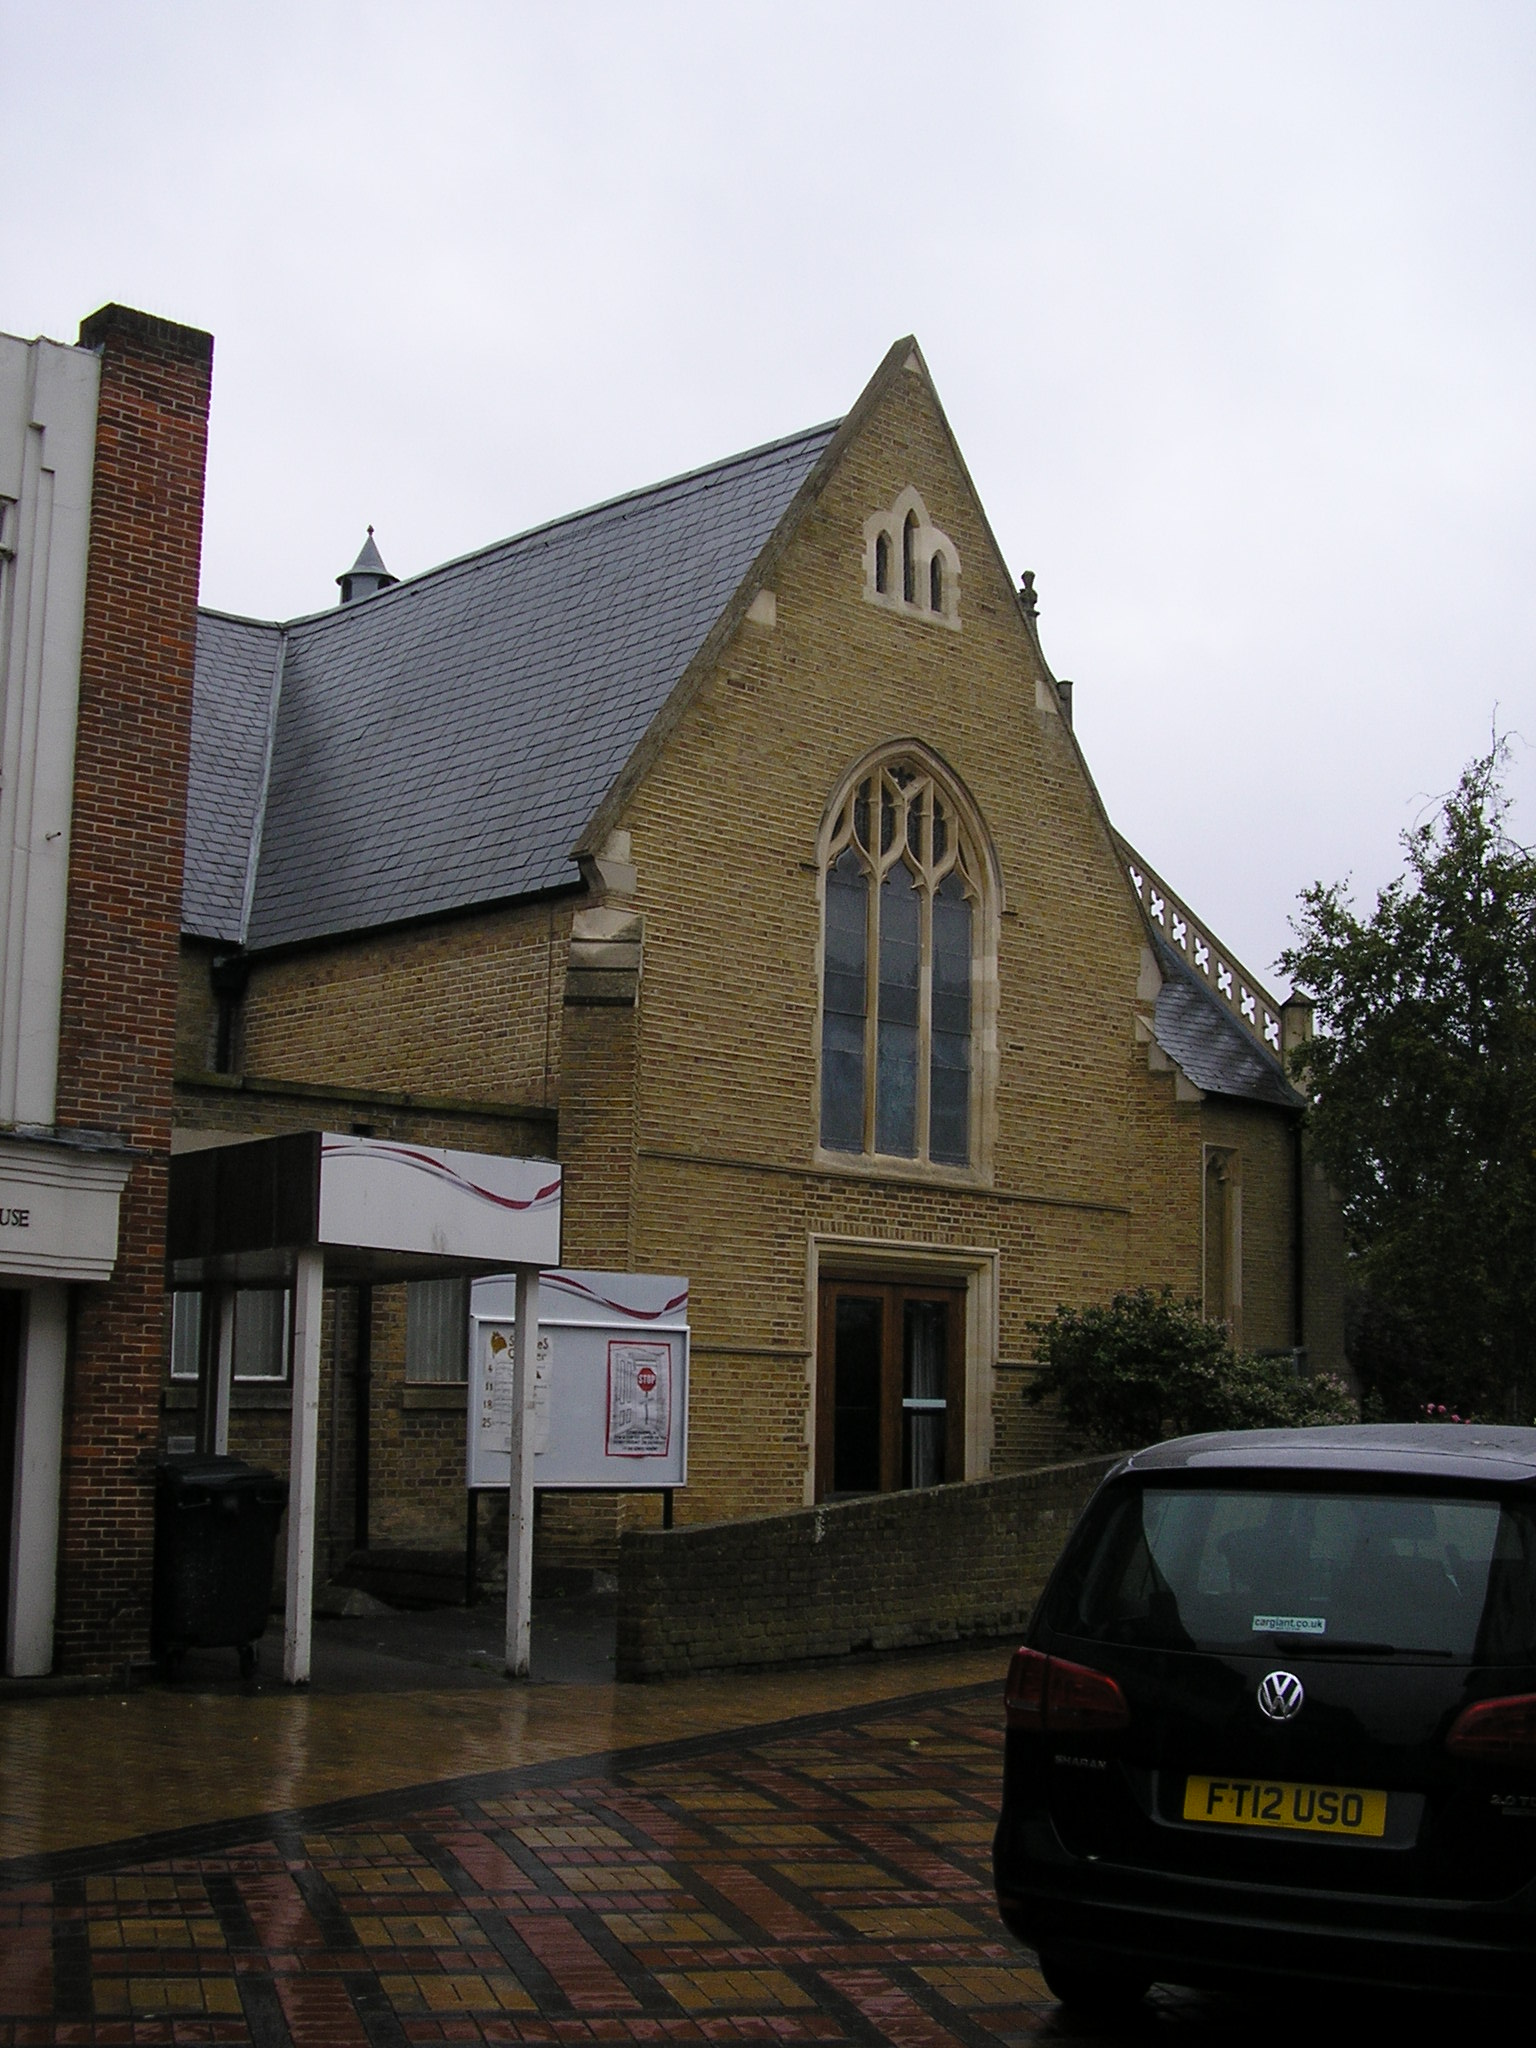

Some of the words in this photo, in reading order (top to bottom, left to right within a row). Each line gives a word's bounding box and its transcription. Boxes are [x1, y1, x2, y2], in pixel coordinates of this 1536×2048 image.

[638, 1374, 656, 1385] STOP
[1255, 1617, 1323, 1630] cargiant.co.uk
[1054, 1755, 1107, 1769] SHARAN
[1206, 1782, 1284, 1820] FT12
